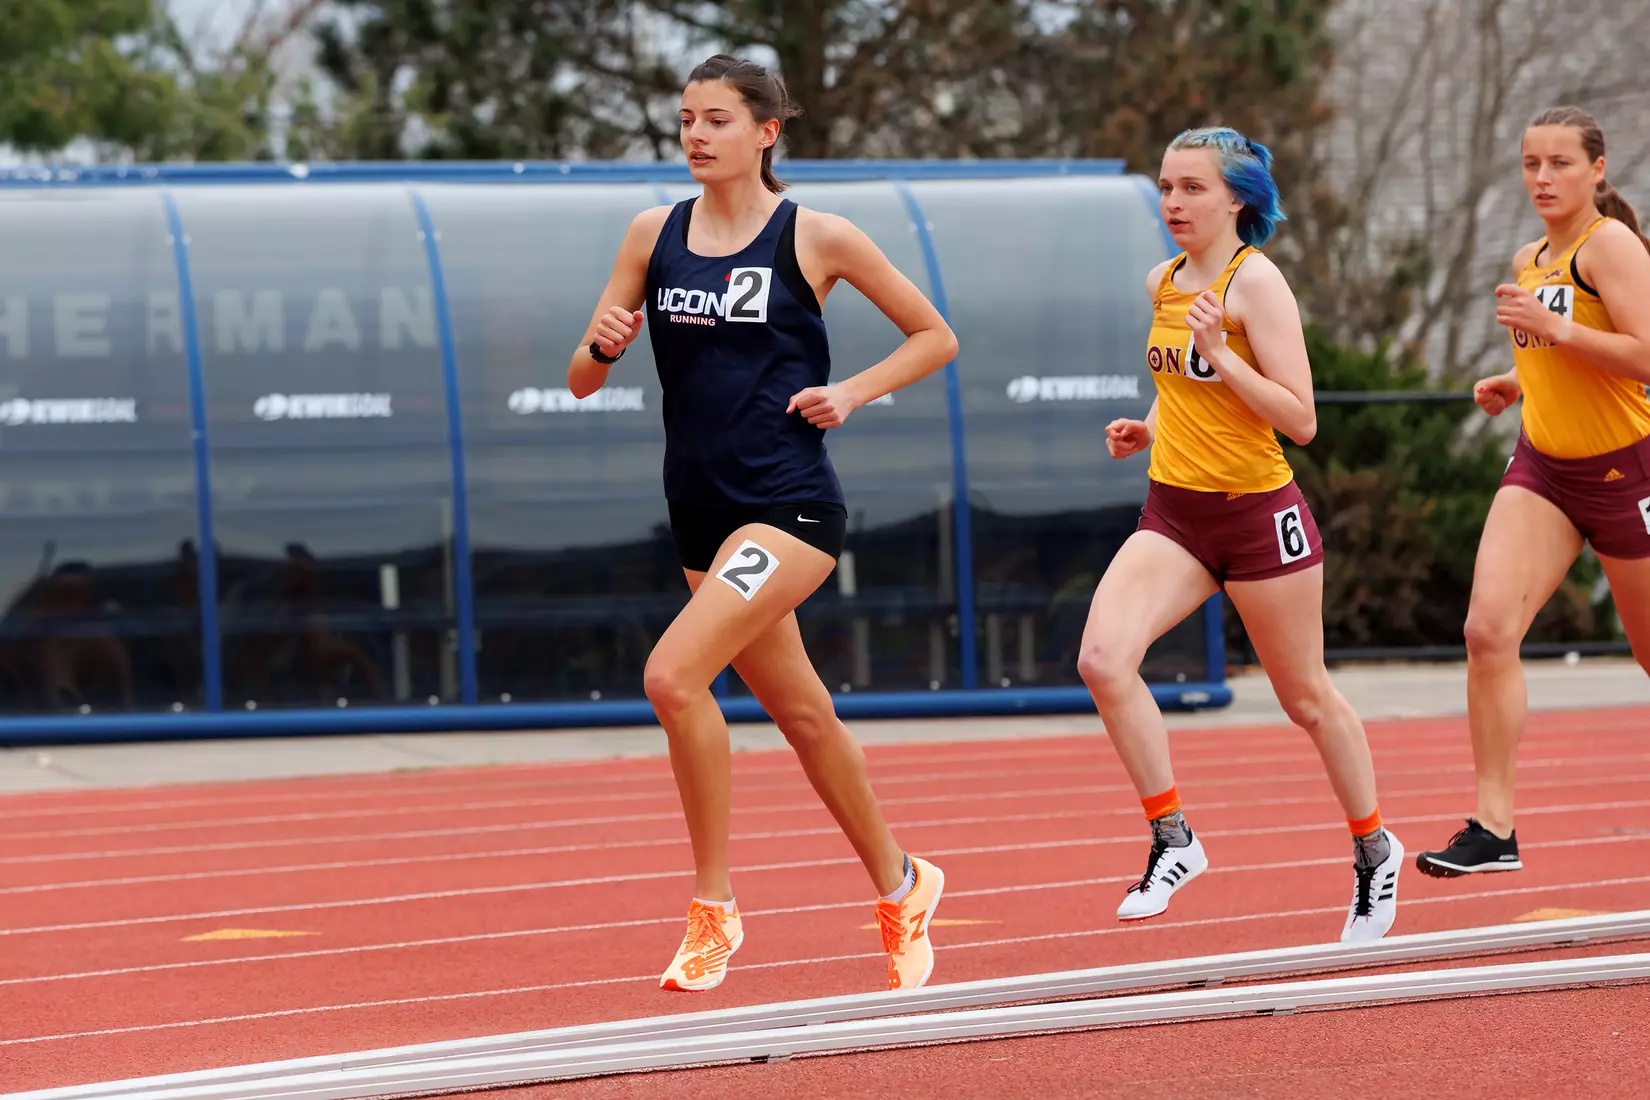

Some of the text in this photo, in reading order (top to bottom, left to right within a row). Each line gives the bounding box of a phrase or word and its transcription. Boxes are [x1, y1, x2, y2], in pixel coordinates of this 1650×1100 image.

[658, 287, 728, 317] UCON
[730, 270, 763, 318] 2
[669, 314, 716, 327] RUNNING
[1147, 346, 1187, 376] ON
[1281, 511, 1304, 557] 6
[722, 547, 769, 594] 2
